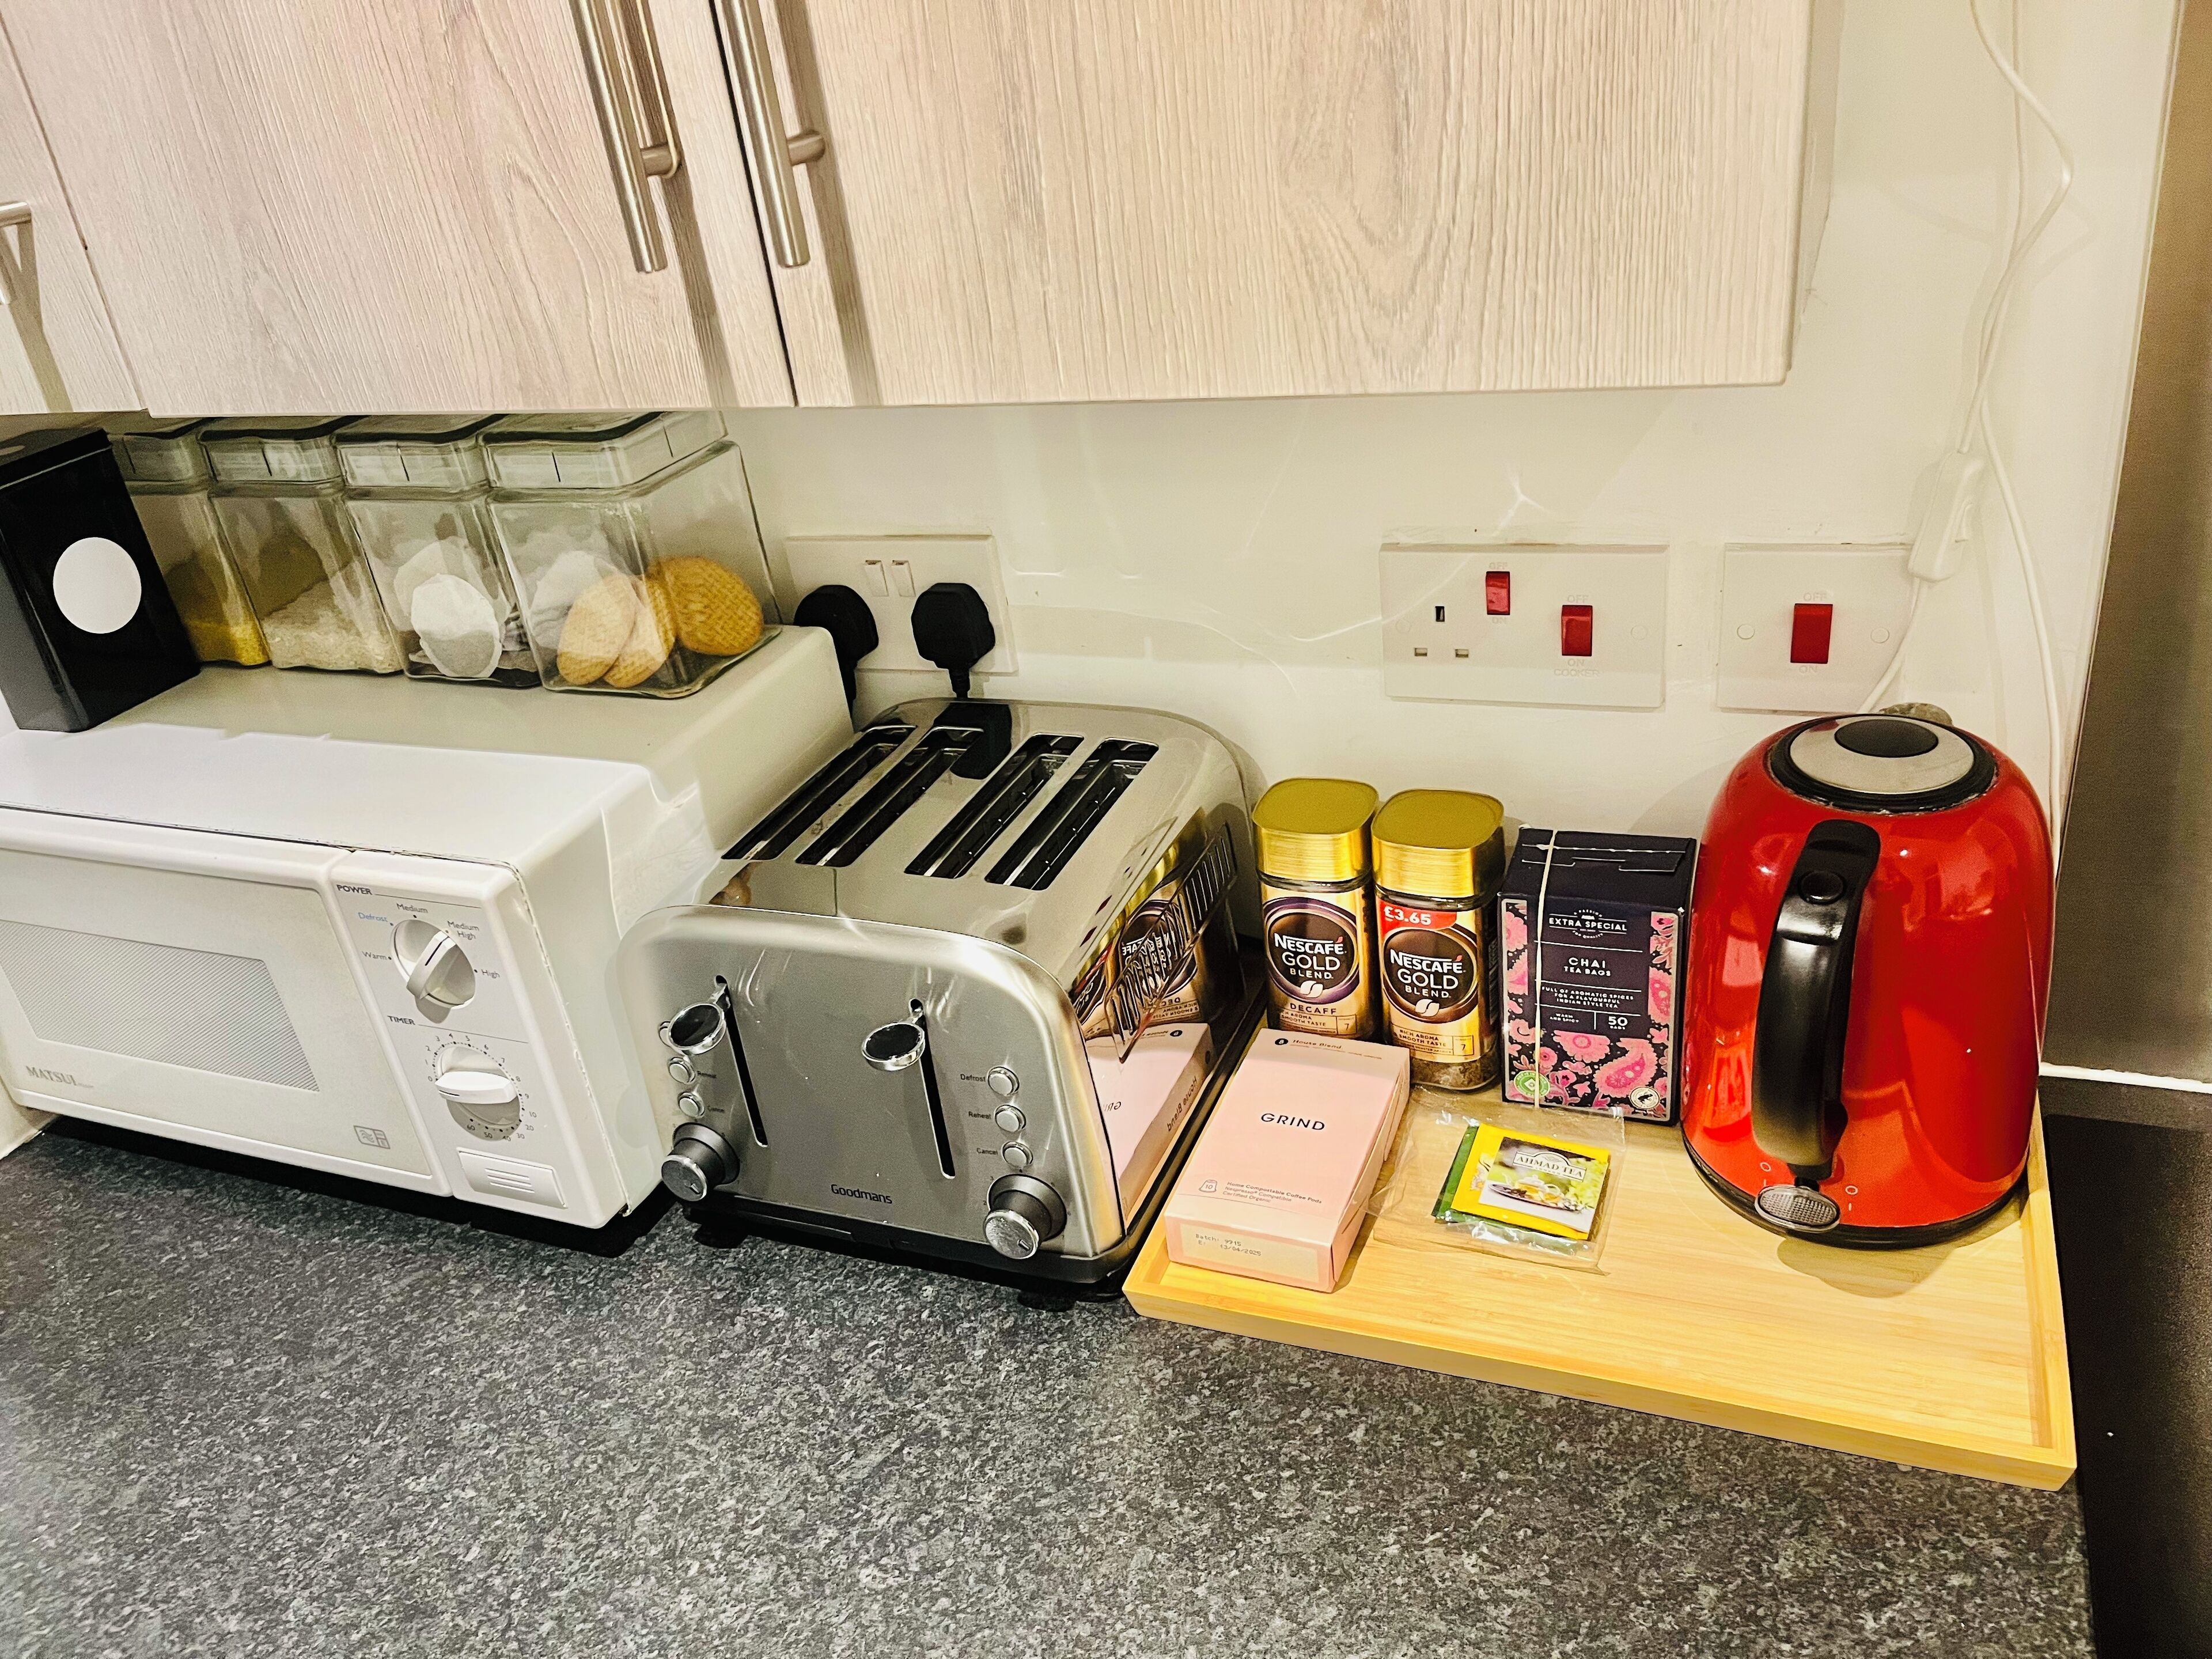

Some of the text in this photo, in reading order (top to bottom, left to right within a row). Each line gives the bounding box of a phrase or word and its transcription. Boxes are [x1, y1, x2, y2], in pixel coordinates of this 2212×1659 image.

[1567, 594, 1589, 603] OFF
[1803, 592, 1827, 601] OFF
[1568, 658, 1584, 666] ON
[1554, 669, 1599, 677] COOKER
[1799, 665, 1817, 673] ON
[336, 884, 373, 895] POWER
[396, 903, 429, 914] Medium
[358, 912, 388, 922] Defrost
[1384, 906, 1432, 926] £3.65
[447, 921, 479, 931] Medium
[1549, 918, 1582, 927] EXTRA
[1585, 921, 1627, 931] SPECIAL
[457, 930, 476, 940] High
[1274, 933, 1344, 955] NESCAFÉ
[362, 951, 387, 960] Warm
[1282, 952, 1340, 971] GOLD
[1390, 949, 1463, 974] NESCAFÉ
[1569, 957, 1605, 968] CHAI
[481, 969, 500, 979] High
[1290, 968, 1332, 979] BLEND
[1563, 966, 1611, 976] TEA BAGS
[1397, 968, 1459, 990] GOLD
[1405, 985, 1450, 998] BLEND
[1575, 995, 1620, 1004] FLAVOURFUL
[1290, 1003, 1337, 1014] DECAFF
[387, 1016, 415, 1025] TIMER
[1608, 1016, 1628, 1027] 50
[1399, 1034, 1425, 1044] SMOOTH
[26, 1066, 77, 1086] MATSUI
[960, 1074, 986, 1082] Defrost
[968, 1111, 991, 1120] Reheat
[1261, 1113, 1325, 1130] GRIND
[1517, 1156, 1559, 1171] AHMAD
[1562, 1165, 1582, 1178] TEA
[831, 1184, 893, 1205] Goodmans
[1222, 1190, 1271, 1203] Certified Organic
[1245, 1184, 1285, 1195] Compostable
[1286, 1192, 1306, 1200] Coffee
[1258, 1191, 1291, 1202] Compatible
[1220, 1244, 1262, 1256] 13/04/2025
